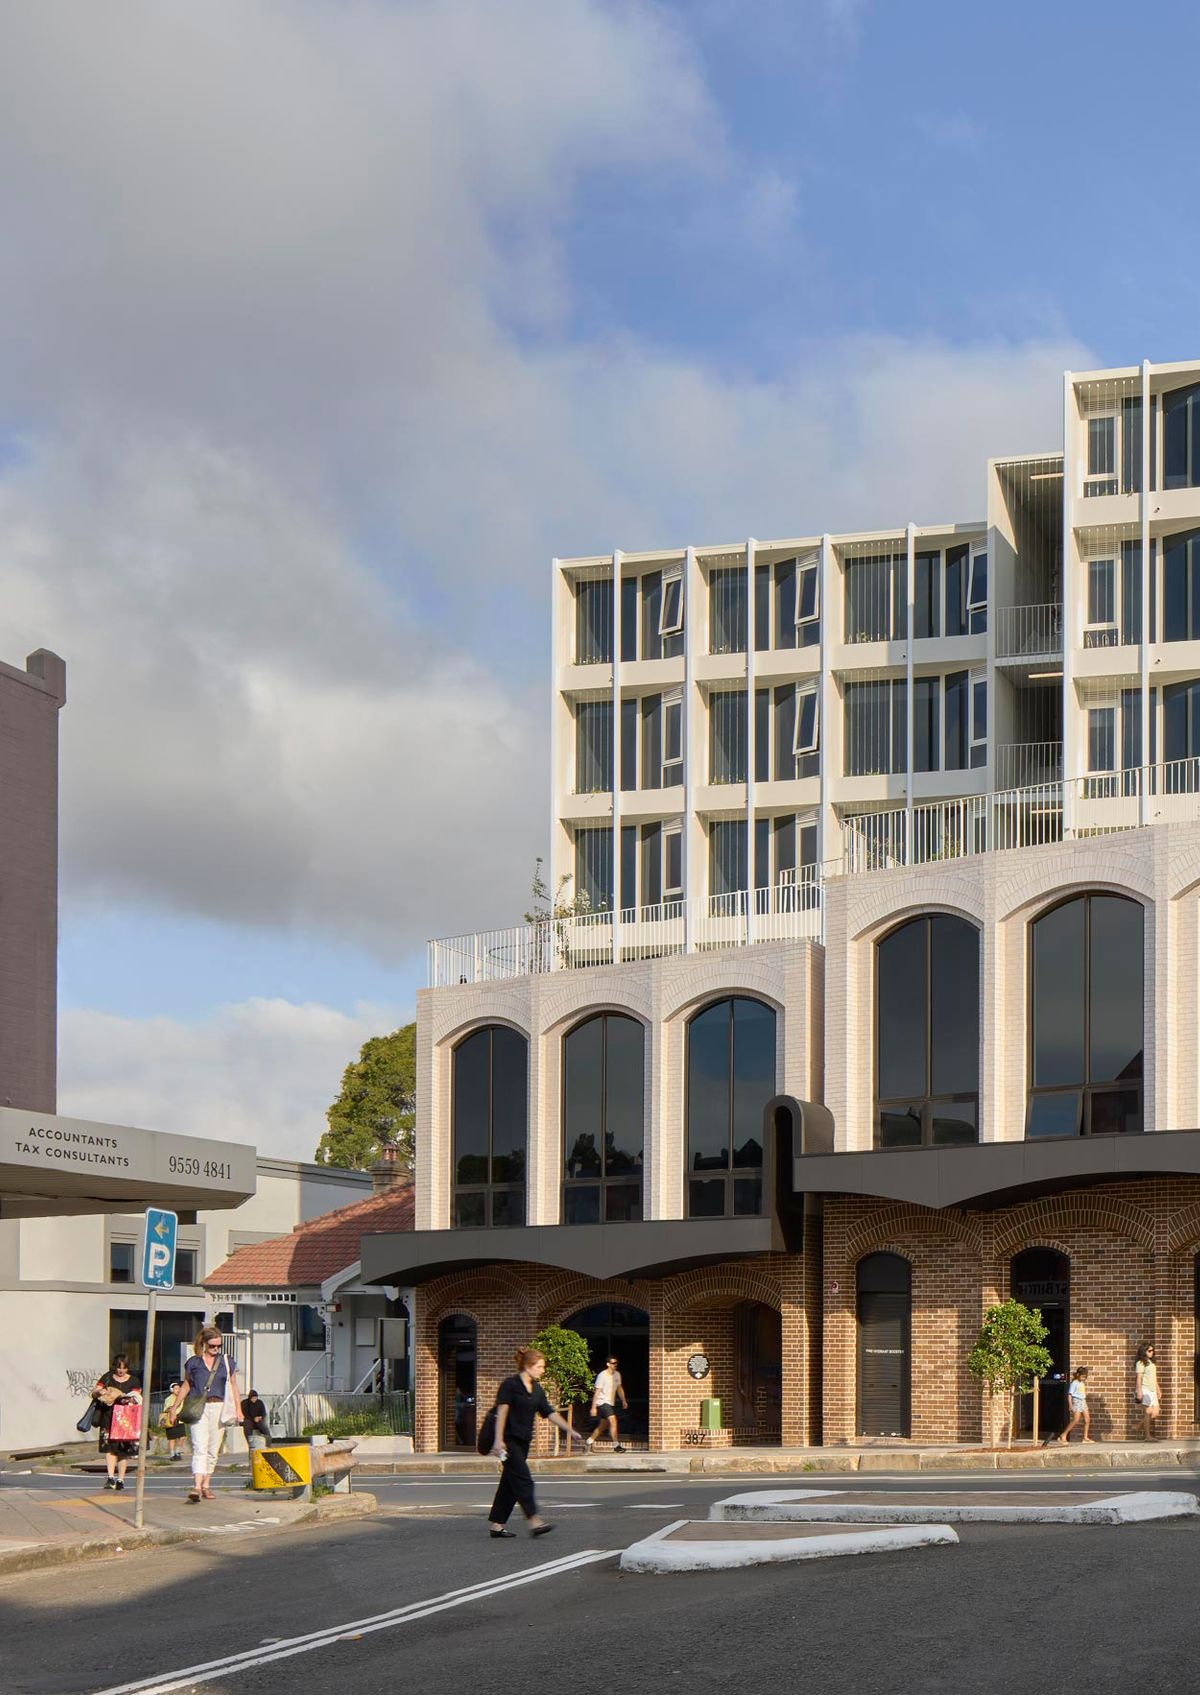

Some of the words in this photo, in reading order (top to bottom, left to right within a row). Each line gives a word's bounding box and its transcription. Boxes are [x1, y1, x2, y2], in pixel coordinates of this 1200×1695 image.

[28, 1127, 118, 1149] ACCOUNTANTS
[15, 1142, 40, 1155] TAX
[45, 1147, 130, 1167] CONSULTANTS
[169, 1155, 200, 1176] 9559
[203, 1160, 232, 1180] 4841
[148, 1242, 170, 1279] P
[685, 1433, 706, 1445] 387
